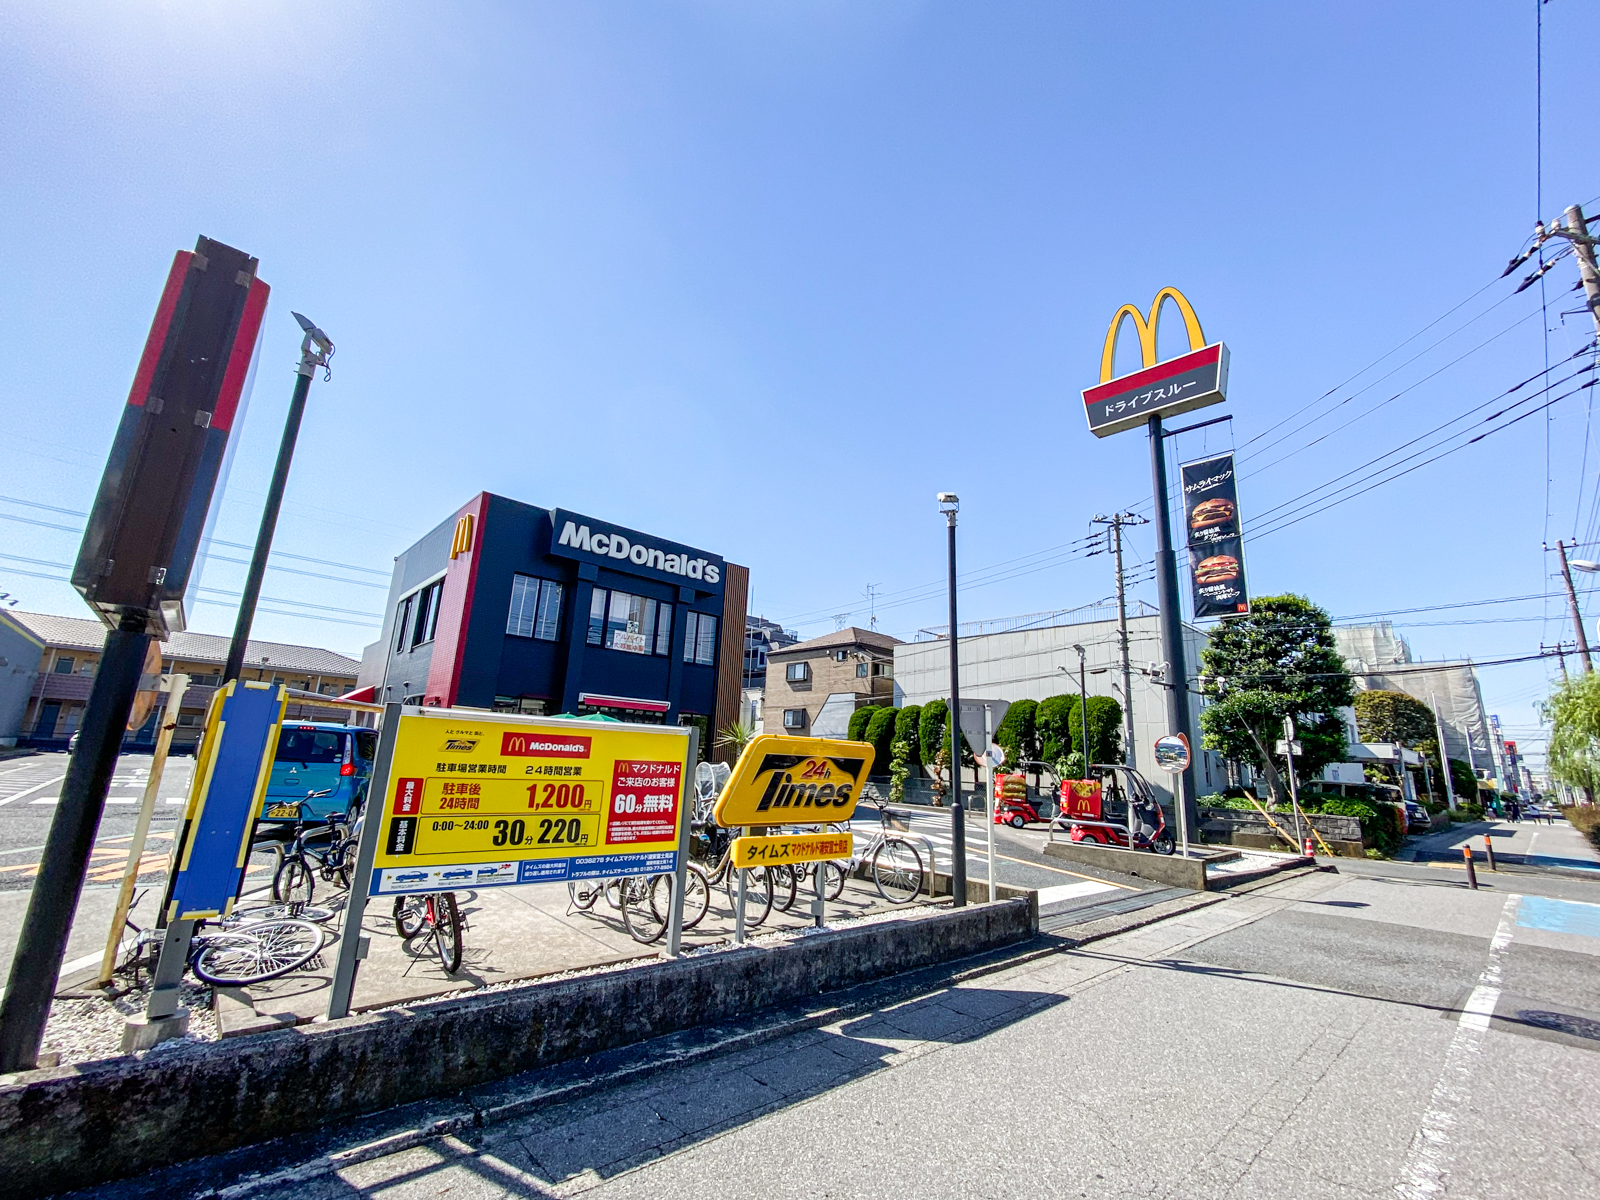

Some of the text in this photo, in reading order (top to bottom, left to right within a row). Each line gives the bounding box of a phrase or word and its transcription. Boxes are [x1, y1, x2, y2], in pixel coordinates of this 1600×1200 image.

[1104, 380, 1197, 417] ドライブスルー
[1184, 470, 1233, 494] サムライマック
[558, 520, 720, 584] McDonald's
[529, 742, 585, 752] McDonald's
[435, 762, 507, 774] 駐車場営業時間
[632, 764, 680, 774] マクドナルド
[441, 783, 482, 795] 駐車後
[617, 777, 676, 788] ご来店のお客様
[756, 771, 853, 812] Times
[439, 797, 480, 810] 24時間
[747, 843, 791, 860] タイムズ
